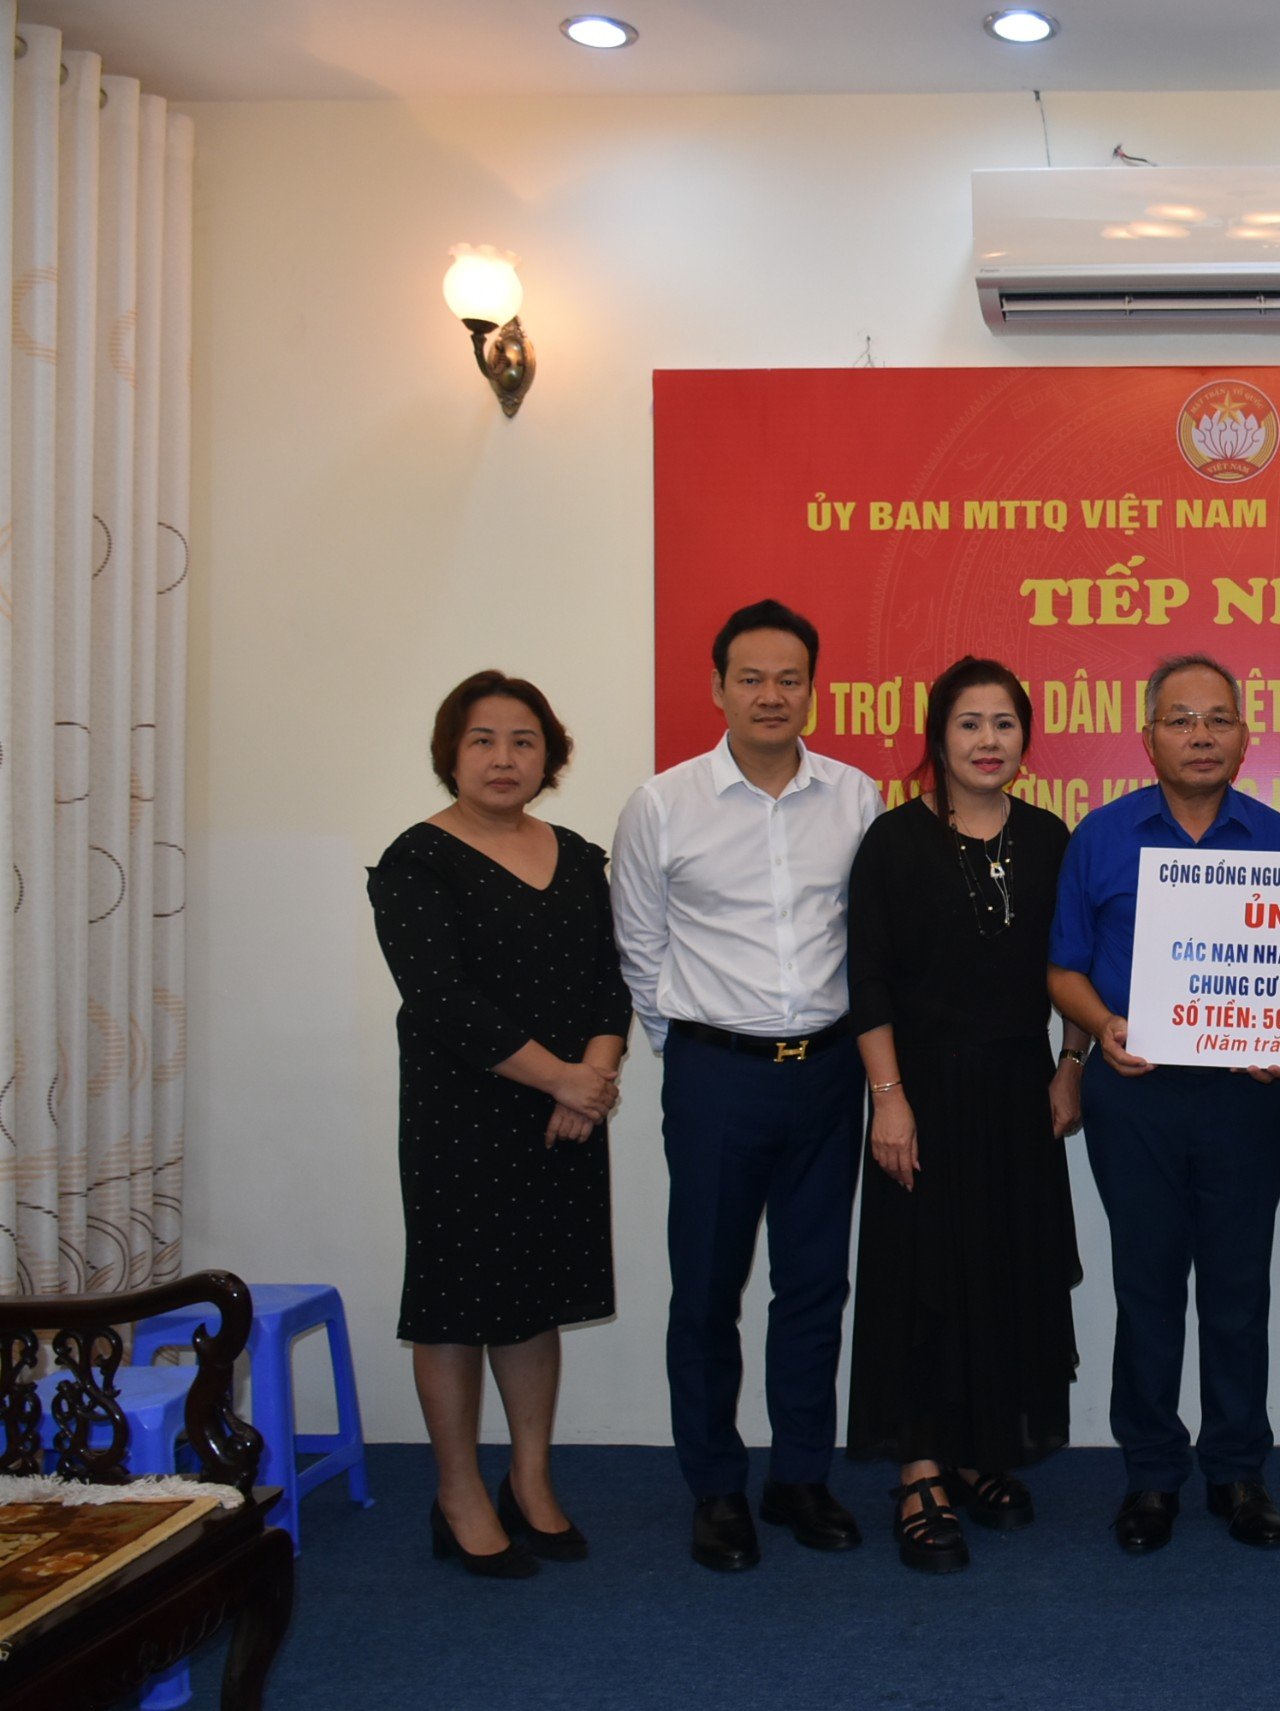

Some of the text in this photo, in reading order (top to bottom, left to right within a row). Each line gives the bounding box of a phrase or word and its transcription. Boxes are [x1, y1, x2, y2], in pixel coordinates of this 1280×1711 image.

[807, 492, 857, 532] ỦY
[869, 500, 950, 531] BAN
[964, 500, 1068, 532] MTTQ
[1082, 493, 1163, 536] VIỆT
[1176, 499, 1267, 529] NAM
[1020, 555, 1191, 627] TIẾP
[829, 676, 902, 748] TRỢ
[1044, 668, 1122, 734] DÂN
[1159, 859, 1201, 888] CỘNG
[1205, 859, 1247, 886] ĐỒNG
[1171, 937, 1207, 963] CÁC
[1211, 943, 1250, 967] NẠN
[1189, 974, 1249, 997] CHUNG
[1254, 975, 1280, 998] CƯ
[1171, 998, 1201, 1027] SỐ
[1204, 999, 1257, 1029] TIỀN:
[1196, 1033, 1248, 1054] (Năm
